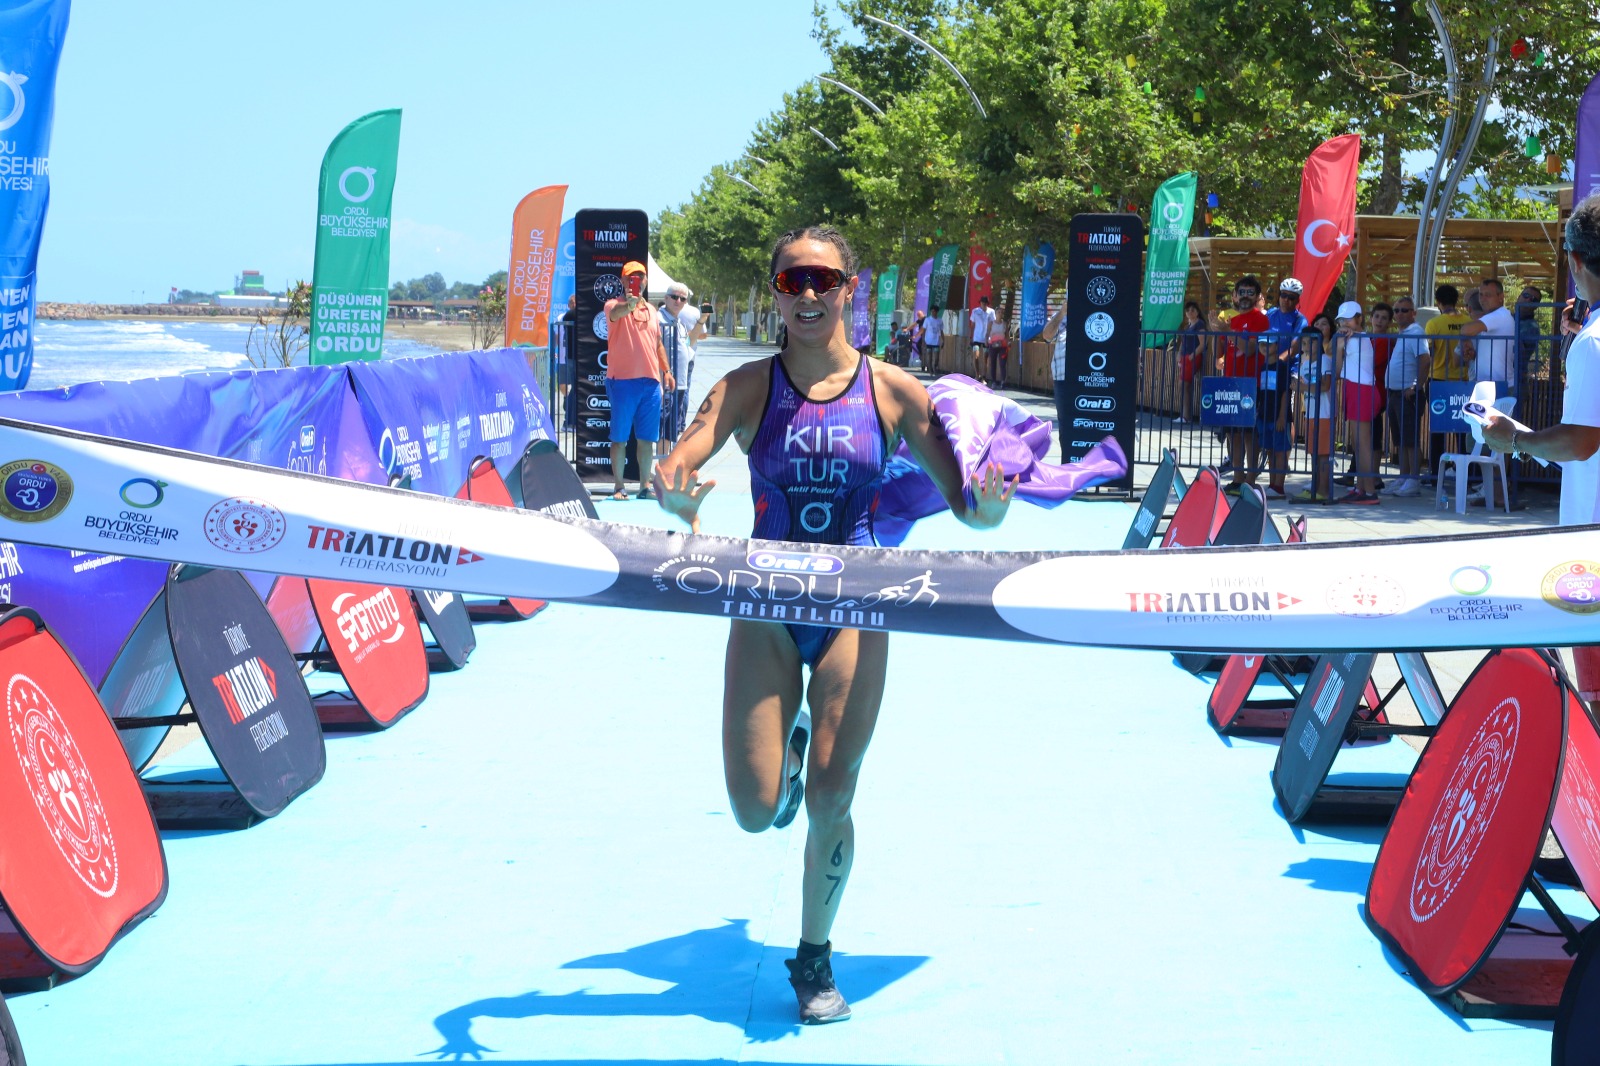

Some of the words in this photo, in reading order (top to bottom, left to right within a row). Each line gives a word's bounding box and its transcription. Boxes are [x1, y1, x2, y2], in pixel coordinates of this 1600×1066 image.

[344, 207, 369, 216] ORDU
[320, 215, 388, 229] BÜYÜKŞEHİR
[331, 228, 377, 237] BELEDİYESİ
[513, 260, 526, 296] ORDU
[1150, 271, 1186, 280] DÜŞÜNEN
[1150, 279, 1185, 287] ÜRETEN
[1150, 287, 1184, 296] YARIŞAN
[319, 292, 382, 307] DÜŞÜNEN
[1149, 295, 1183, 304] ORDU
[318, 307, 382, 321] ÜRETEN
[318, 322, 381, 336] YARIŞAN
[316, 336, 381, 352] ORDU
[1079, 399, 1111, 409] Oral-B
[784, 424, 856, 453] KIR
[790, 458, 850, 484] TUR
[19, 478, 46, 489] ORDU
[810, 486, 835, 494] Pedal
[119, 511, 152, 524] ORDU
[340, 556, 447, 577] FEDERASYONU
[755, 554, 834, 572] Oral-B
[676, 566, 842, 604] ORDU
[1566, 580, 1593, 590] ORDU
[1166, 614, 1273, 624] FEDERASYONU
